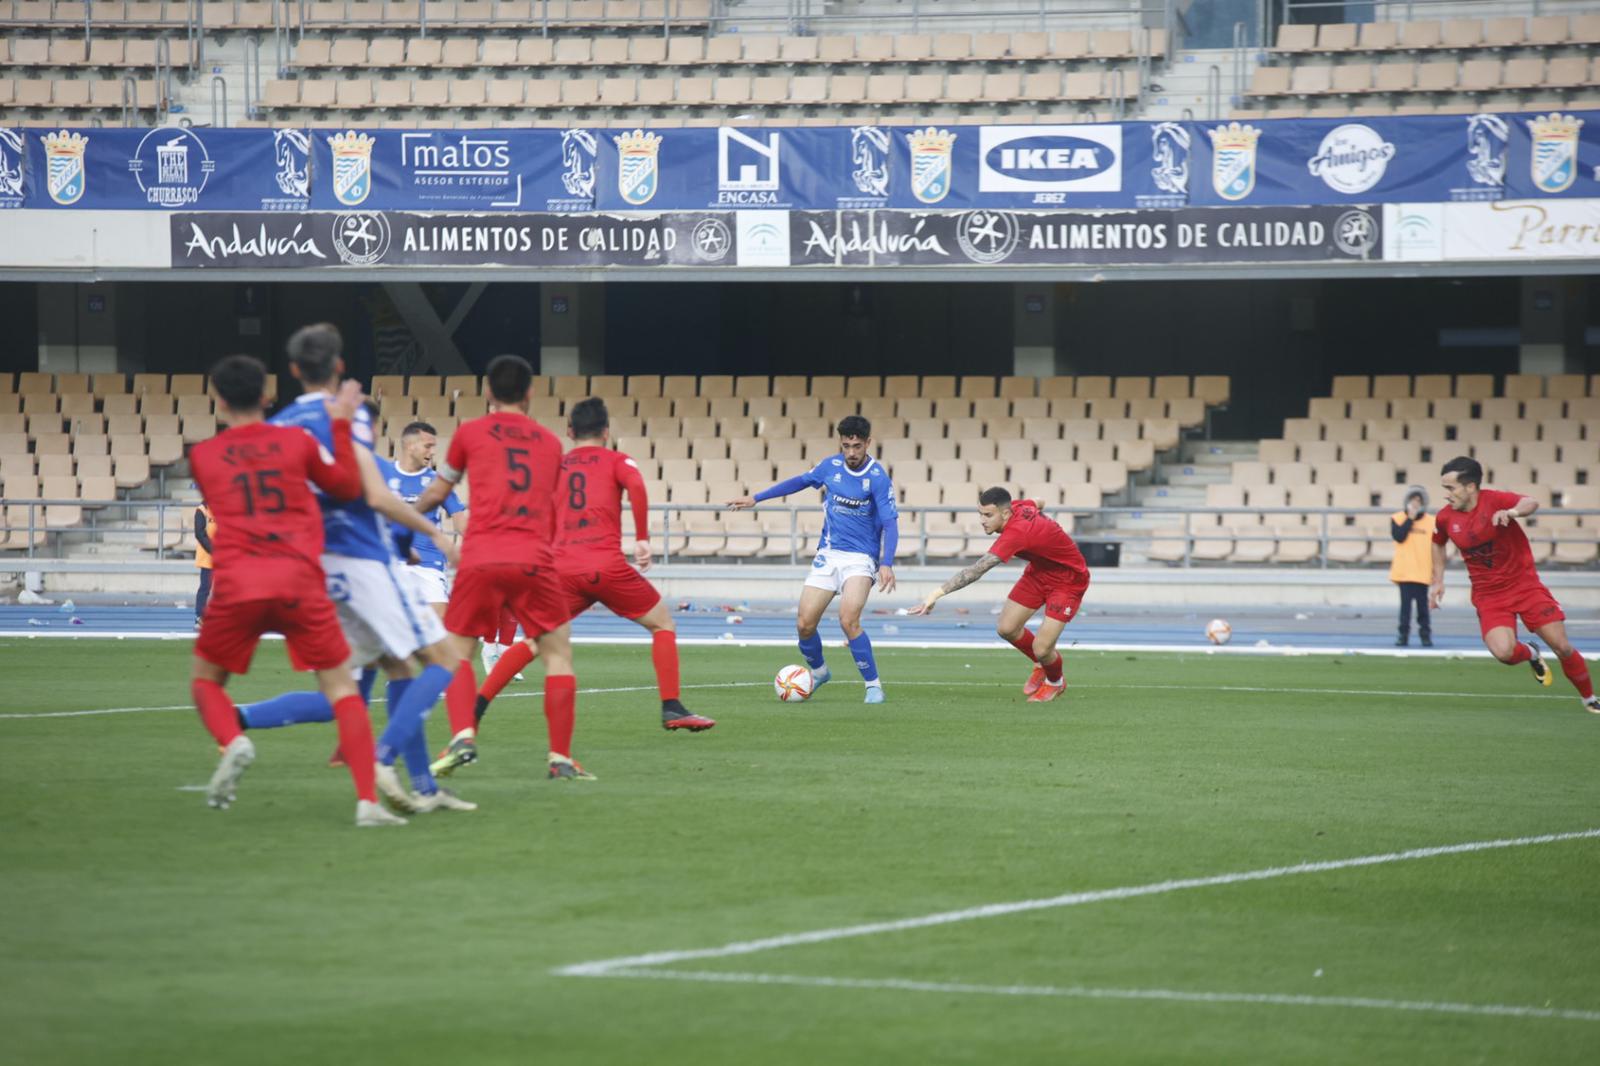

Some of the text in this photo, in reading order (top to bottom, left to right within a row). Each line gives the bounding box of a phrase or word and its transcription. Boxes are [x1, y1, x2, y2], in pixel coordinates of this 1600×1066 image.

[161, 152, 184, 166] THE
[414, 135, 510, 169] matos
[1000, 148, 1099, 170] IKEA
[1313, 144, 1389, 173] Amigos
[147, 187, 199, 203] CHURRASCO
[414, 177, 509, 186] ASESOR EXTERIOR
[718, 191, 779, 203] ENCASA
[185, 222, 327, 260] Andalucía
[403, 227, 532, 253] ALIMENTOS
[542, 227, 569, 252] DE
[803, 219, 950, 257] Andalucía
[1028, 220, 1325, 250] ALIMENTOS DE CALIDAD
[506, 447, 533, 493] 5
[233, 468, 287, 517] 15
[568, 471, 587, 511] 8
